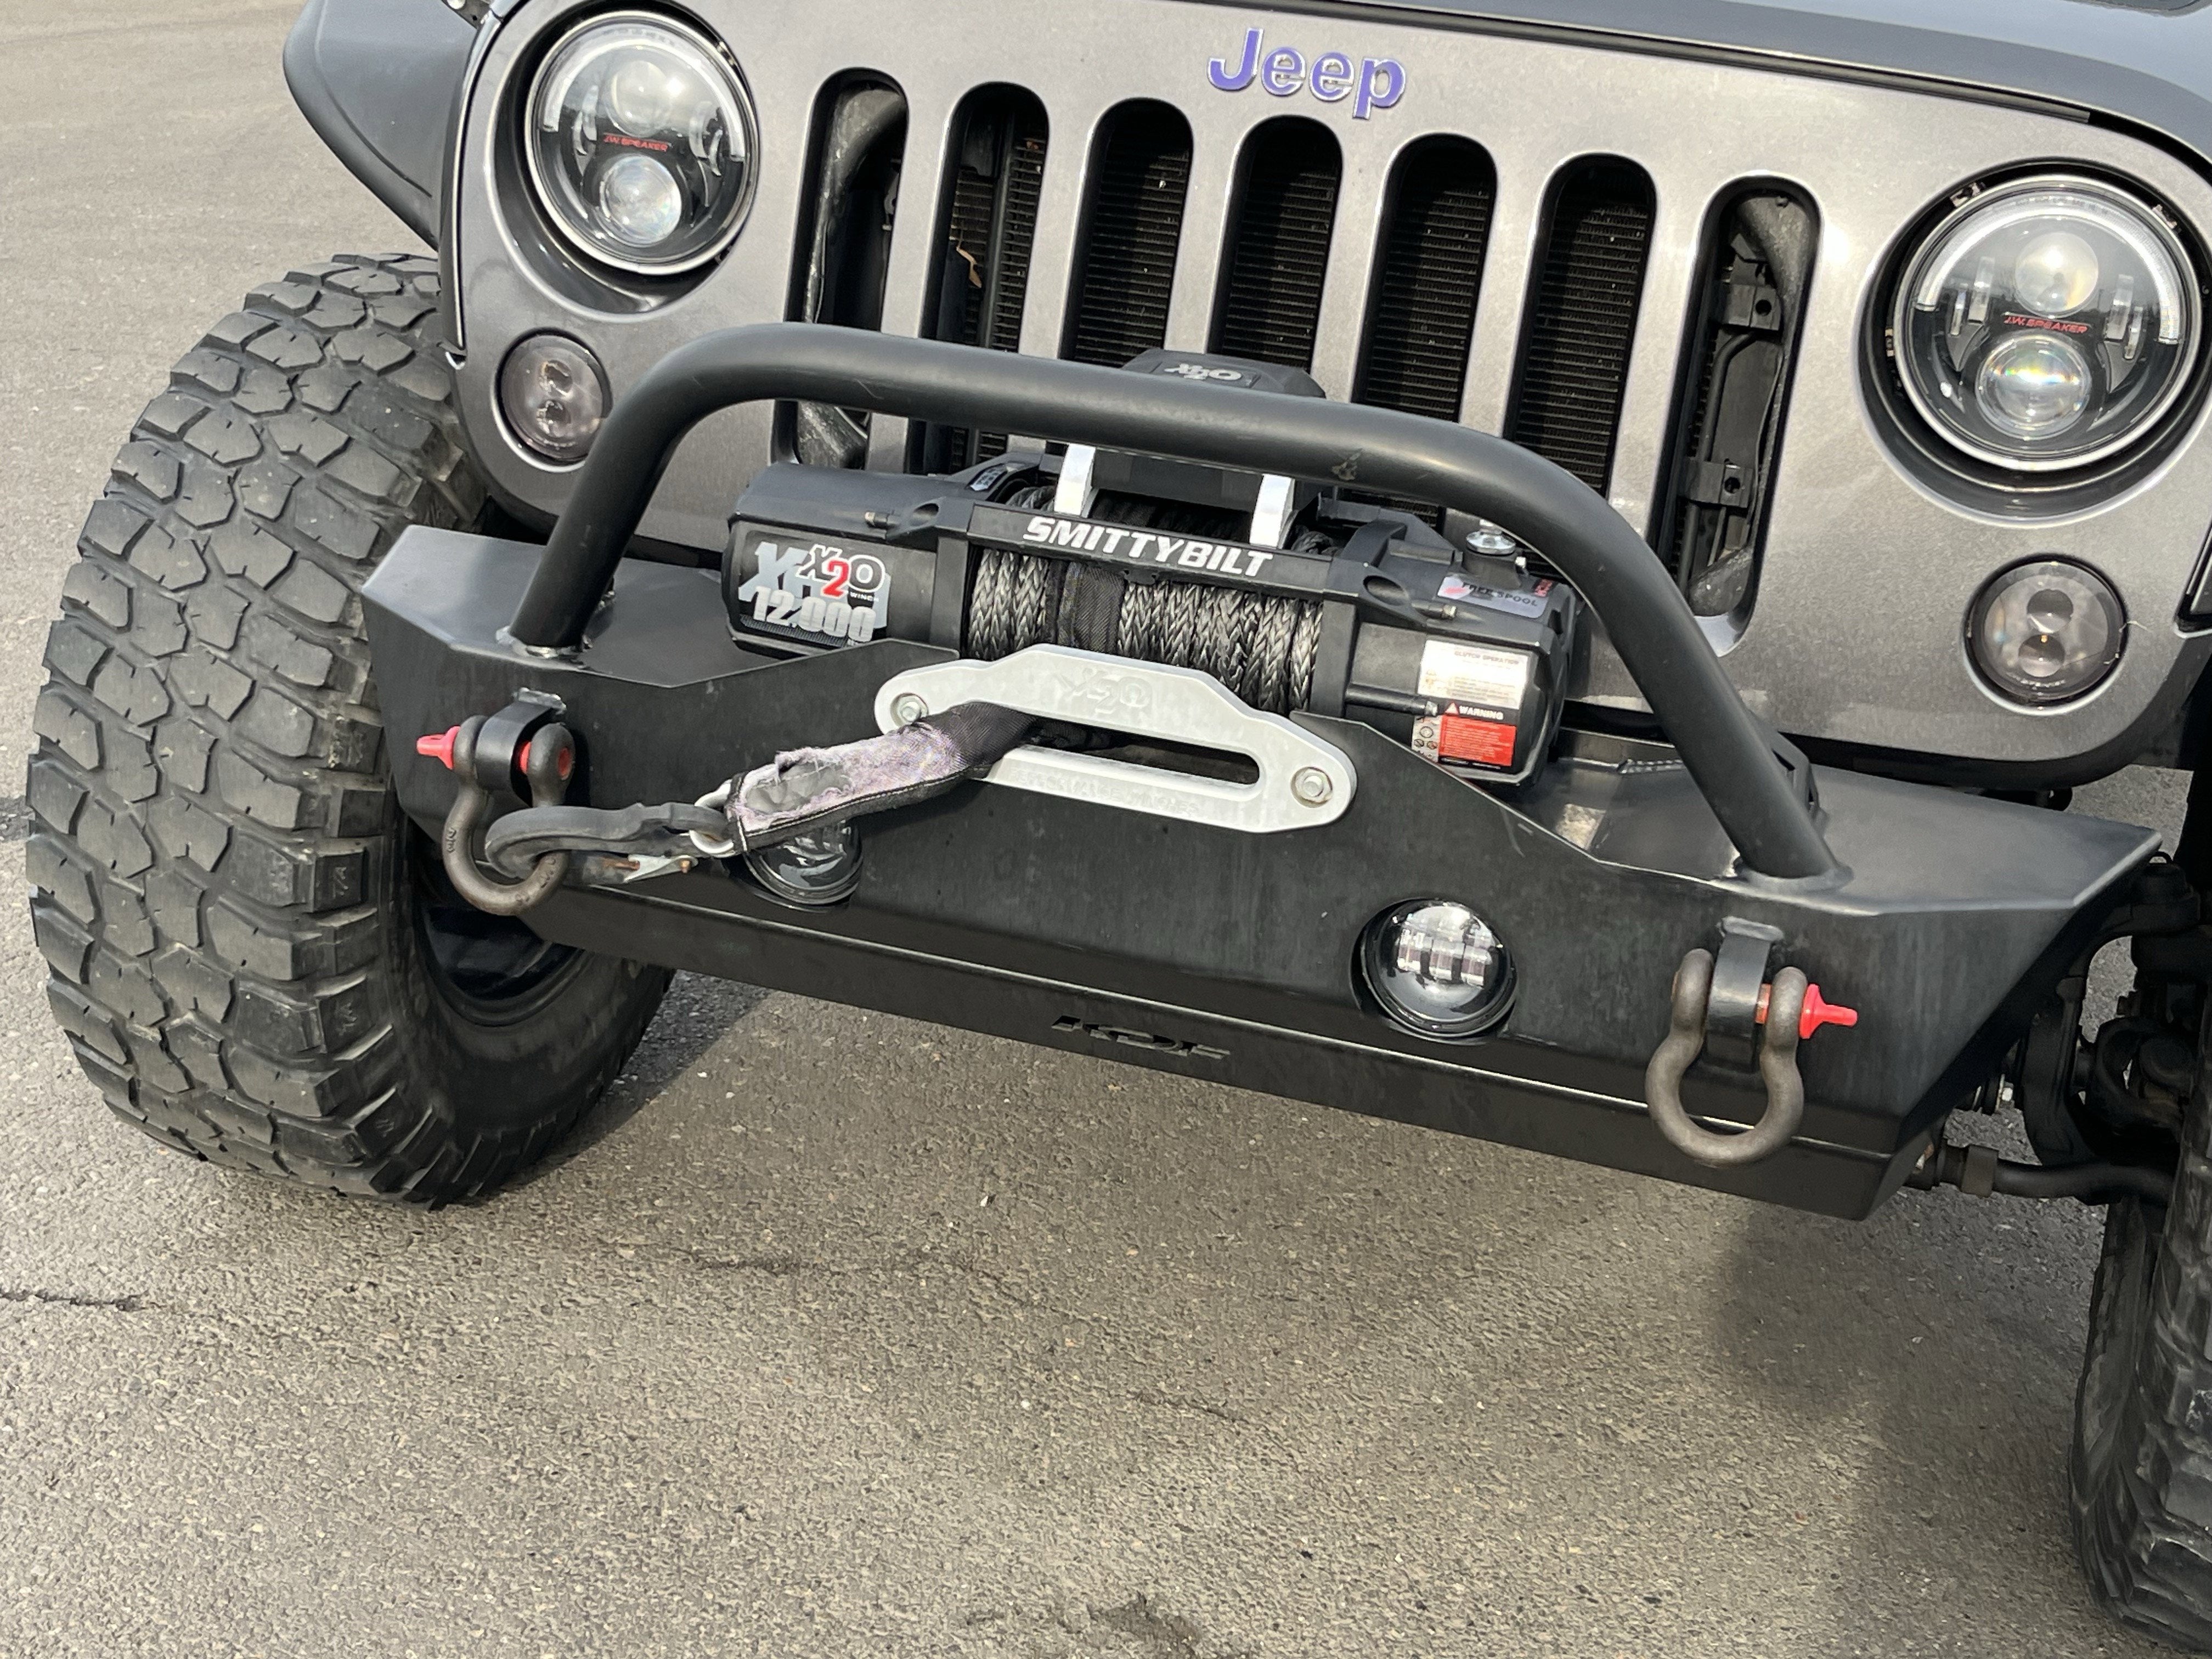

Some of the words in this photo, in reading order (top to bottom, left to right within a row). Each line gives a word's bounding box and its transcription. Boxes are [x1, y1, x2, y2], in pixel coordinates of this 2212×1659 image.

[1207, 27, 1406, 120] Jeep
[2026, 319, 2088, 334] SPEAKER
[1023, 516, 1273, 577] SMITTYBILT
[1497, 590, 1538, 607] SPOOL
[1482, 654, 1519, 665] OPERATION
[1459, 705, 1504, 720] WARNING
